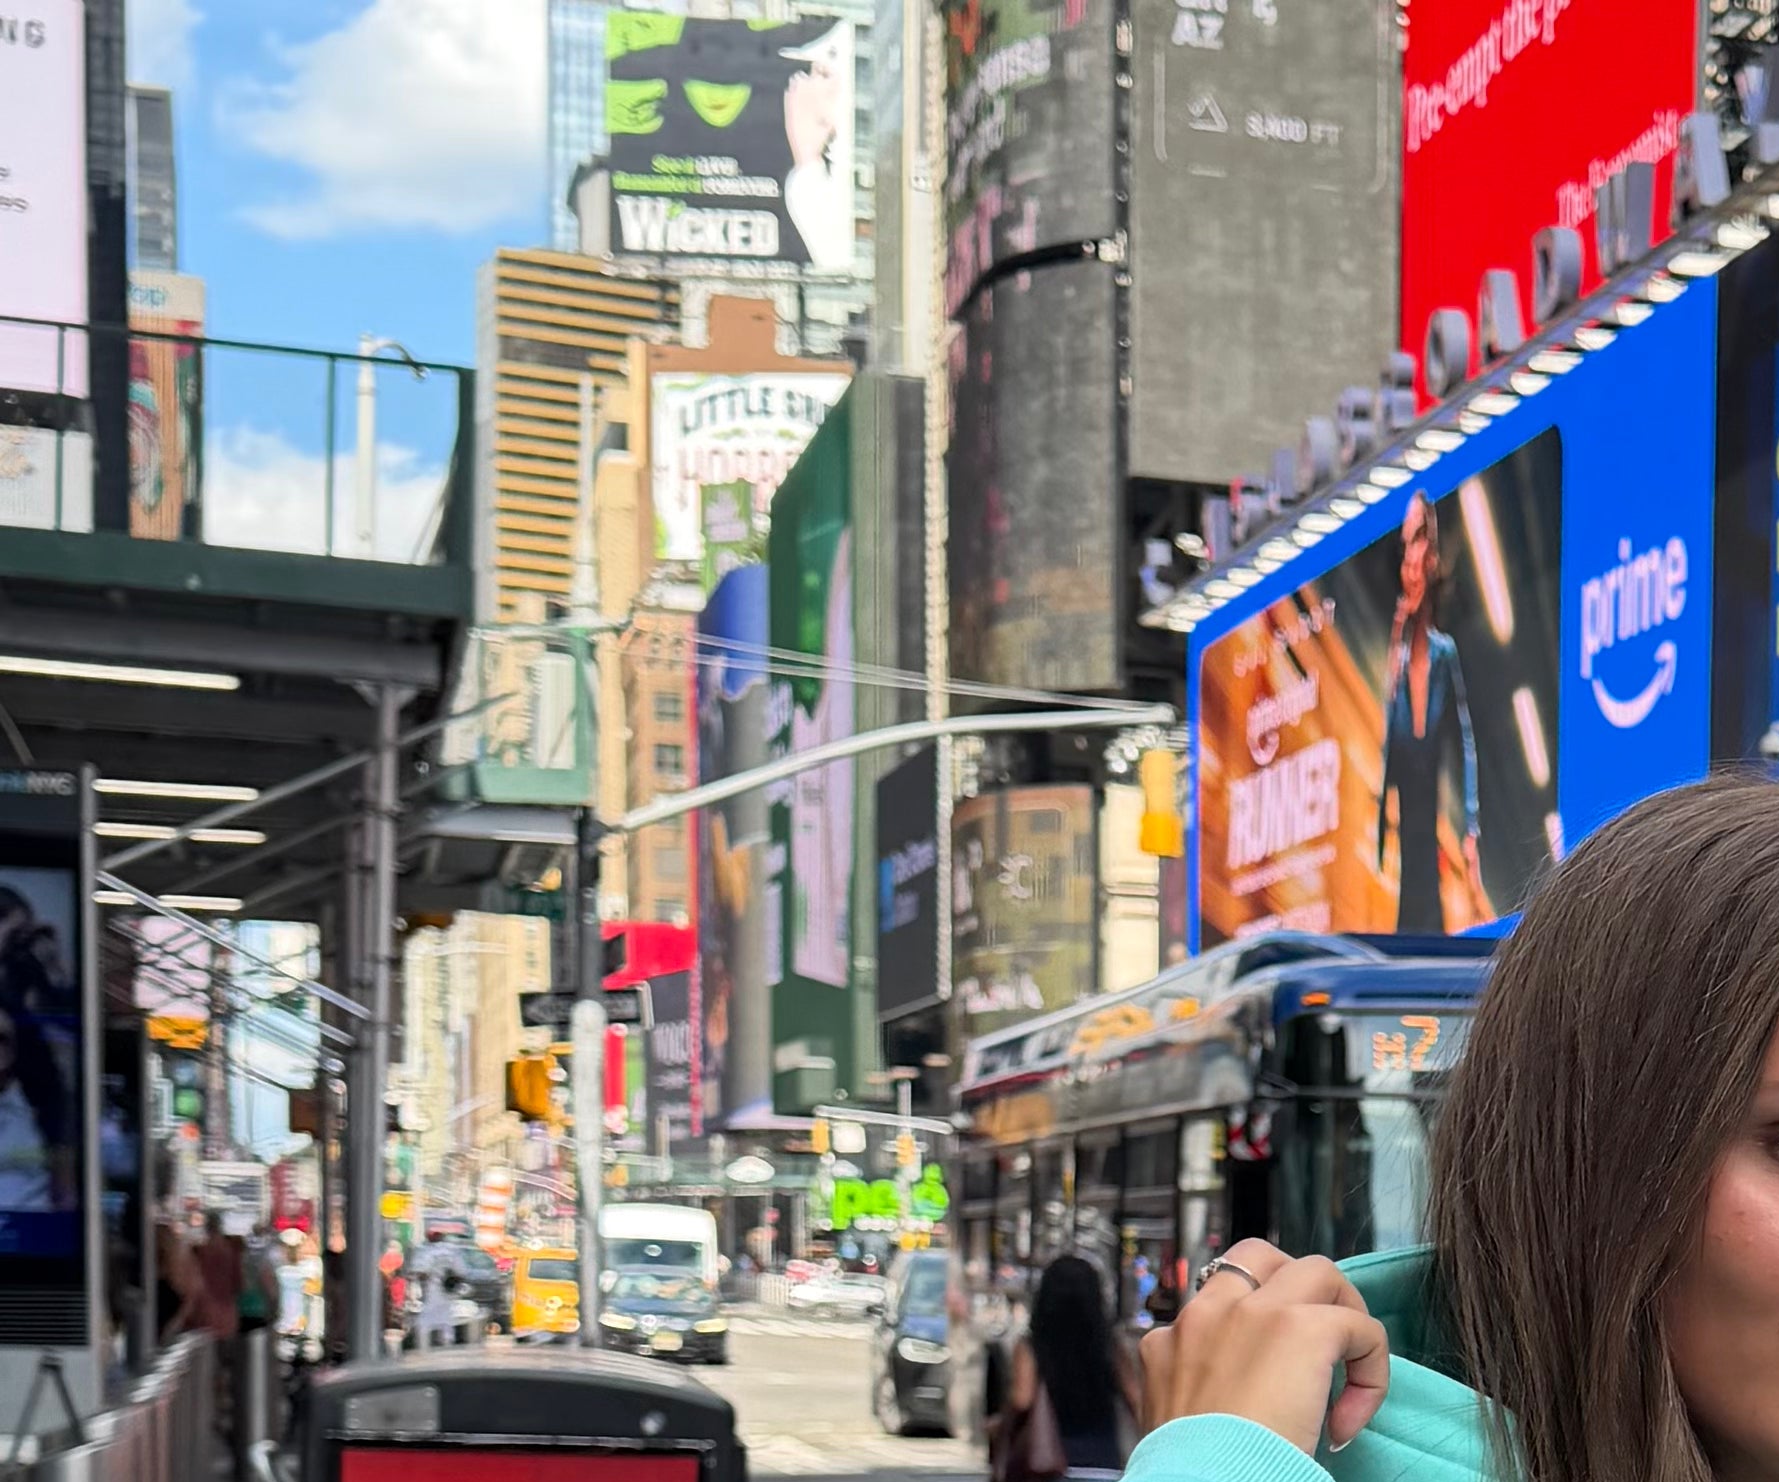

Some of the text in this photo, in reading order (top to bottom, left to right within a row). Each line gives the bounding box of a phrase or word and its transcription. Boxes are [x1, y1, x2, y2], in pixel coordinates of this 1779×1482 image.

[615, 195, 780, 257] WICKED
[679, 386, 775, 437] LITTLE
[1580, 535, 1689, 680] prime
